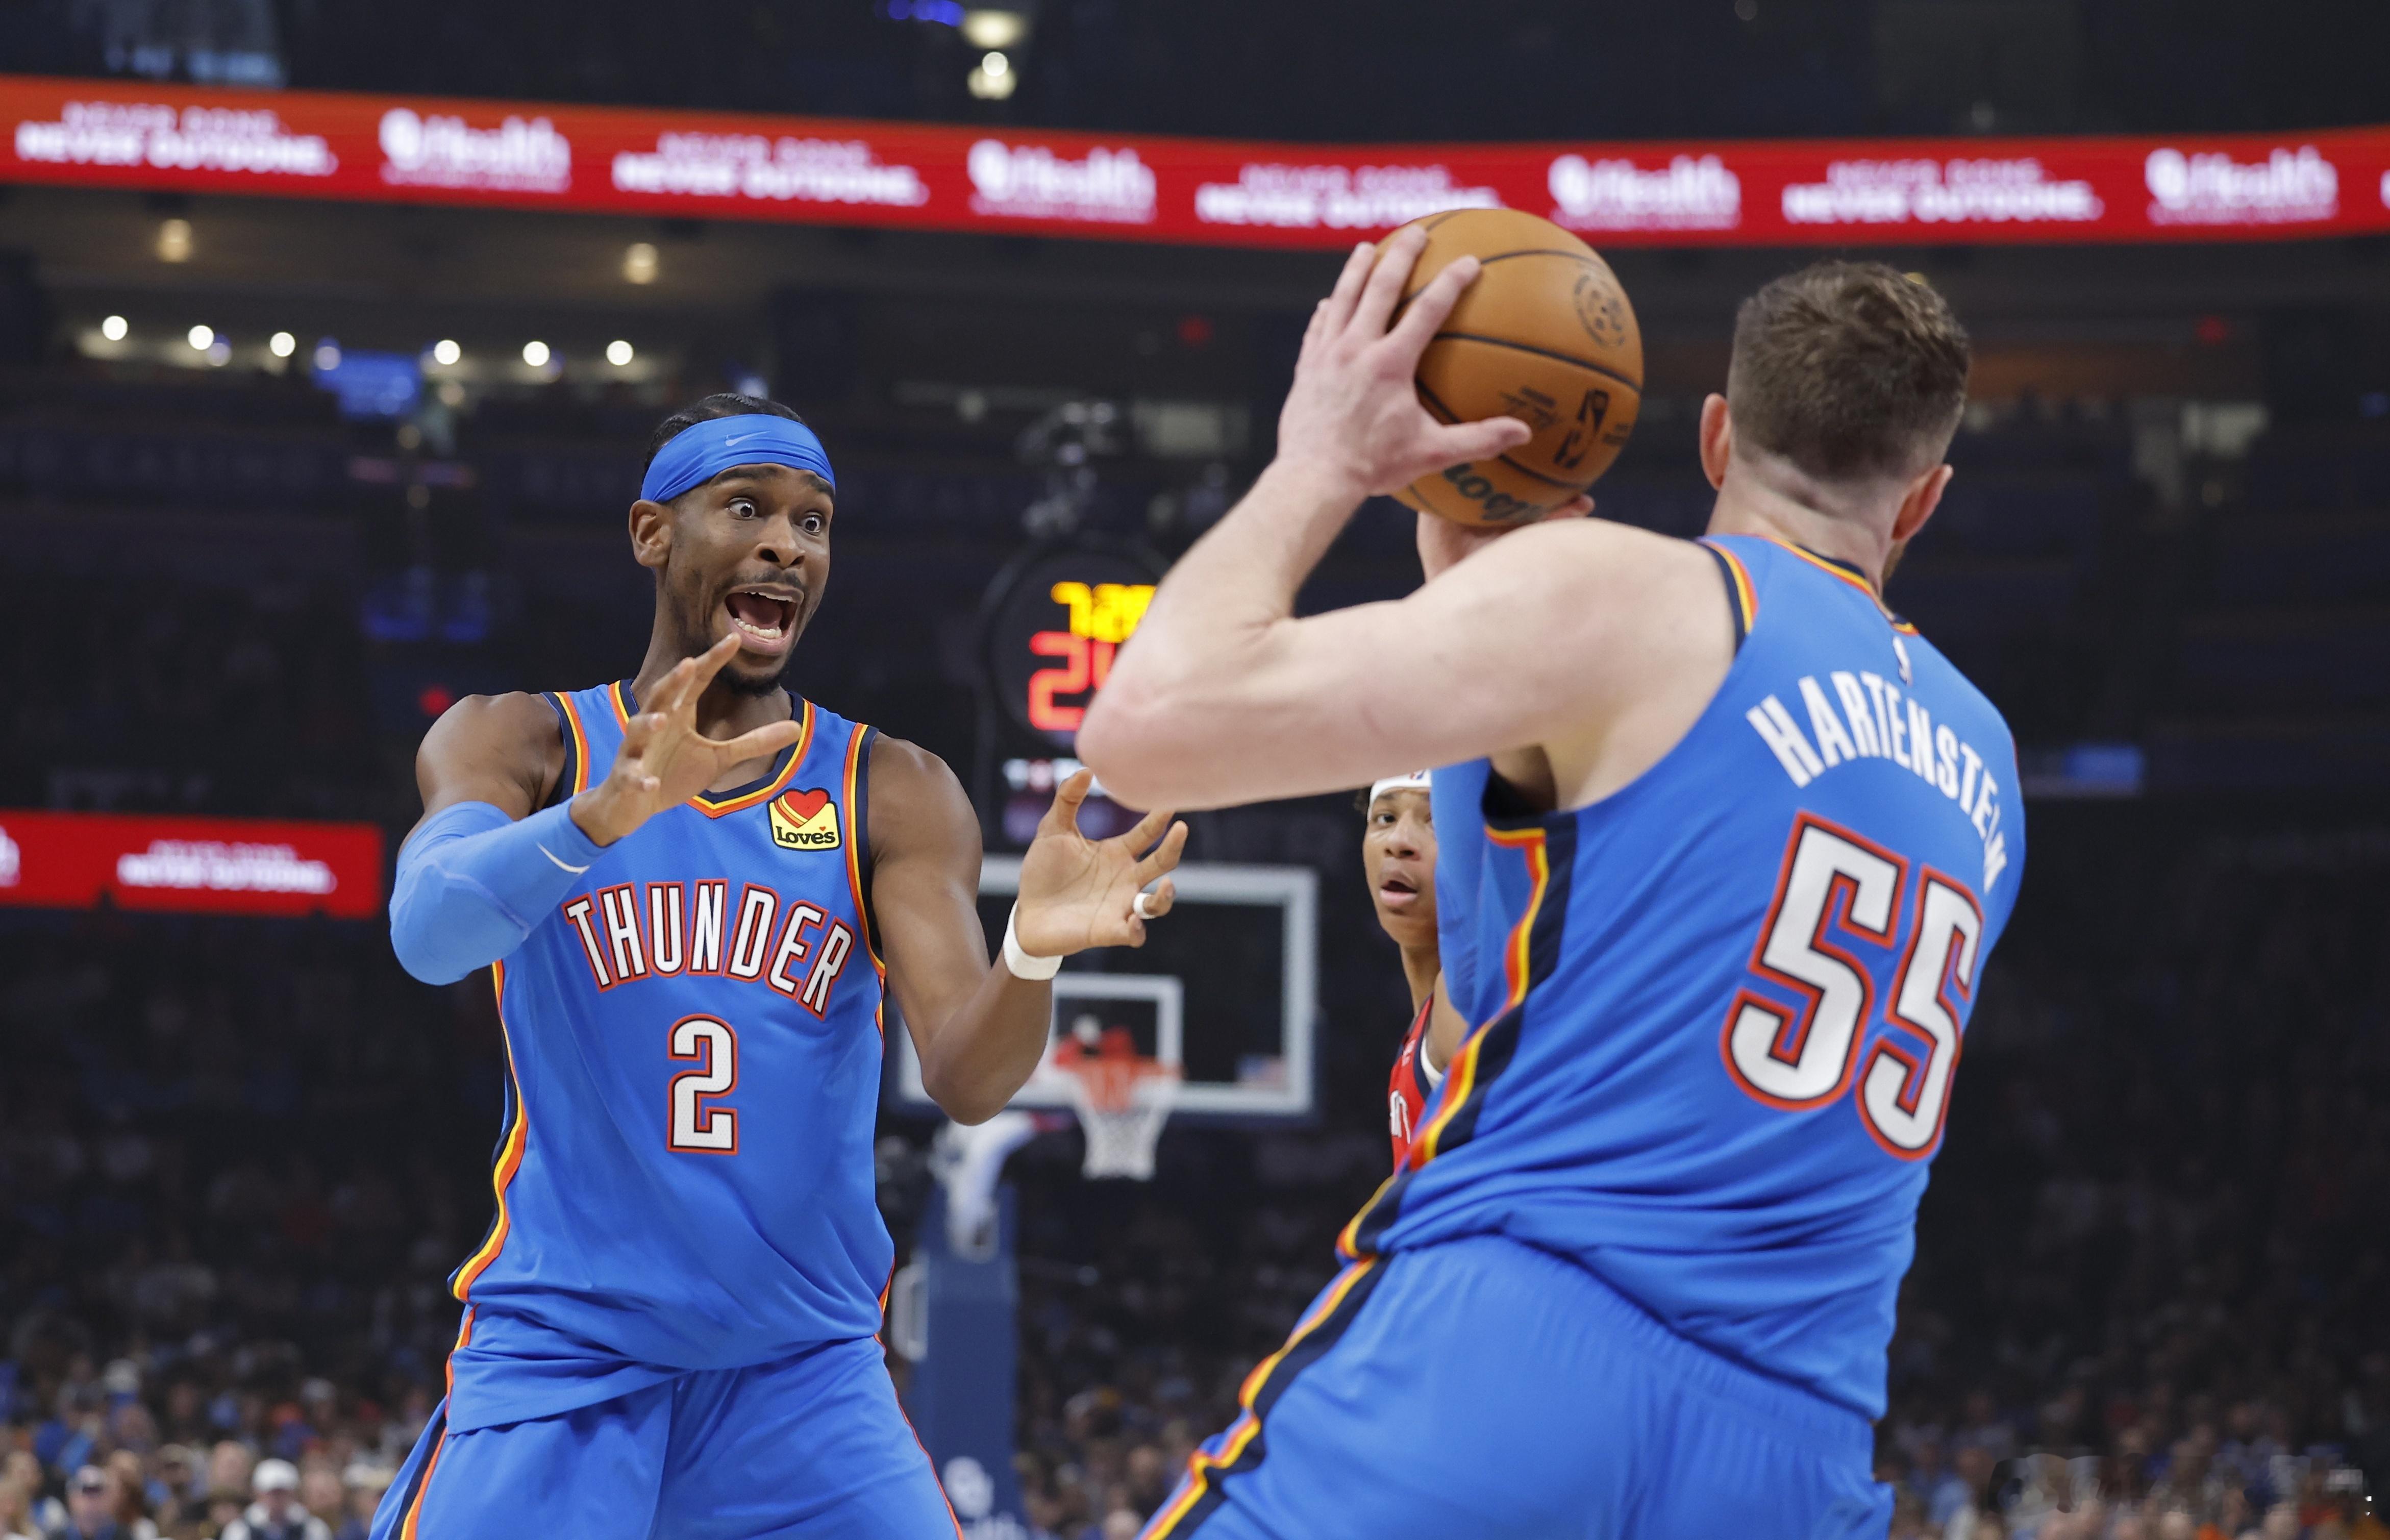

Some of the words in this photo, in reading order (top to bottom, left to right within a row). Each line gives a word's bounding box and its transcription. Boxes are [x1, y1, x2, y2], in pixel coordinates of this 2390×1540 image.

[1029, 630, 1117, 731] 2
[561, 878, 856, 1020] THUNDER
[1720, 808, 1985, 1160] 55
[667, 1013, 738, 1155] 2
